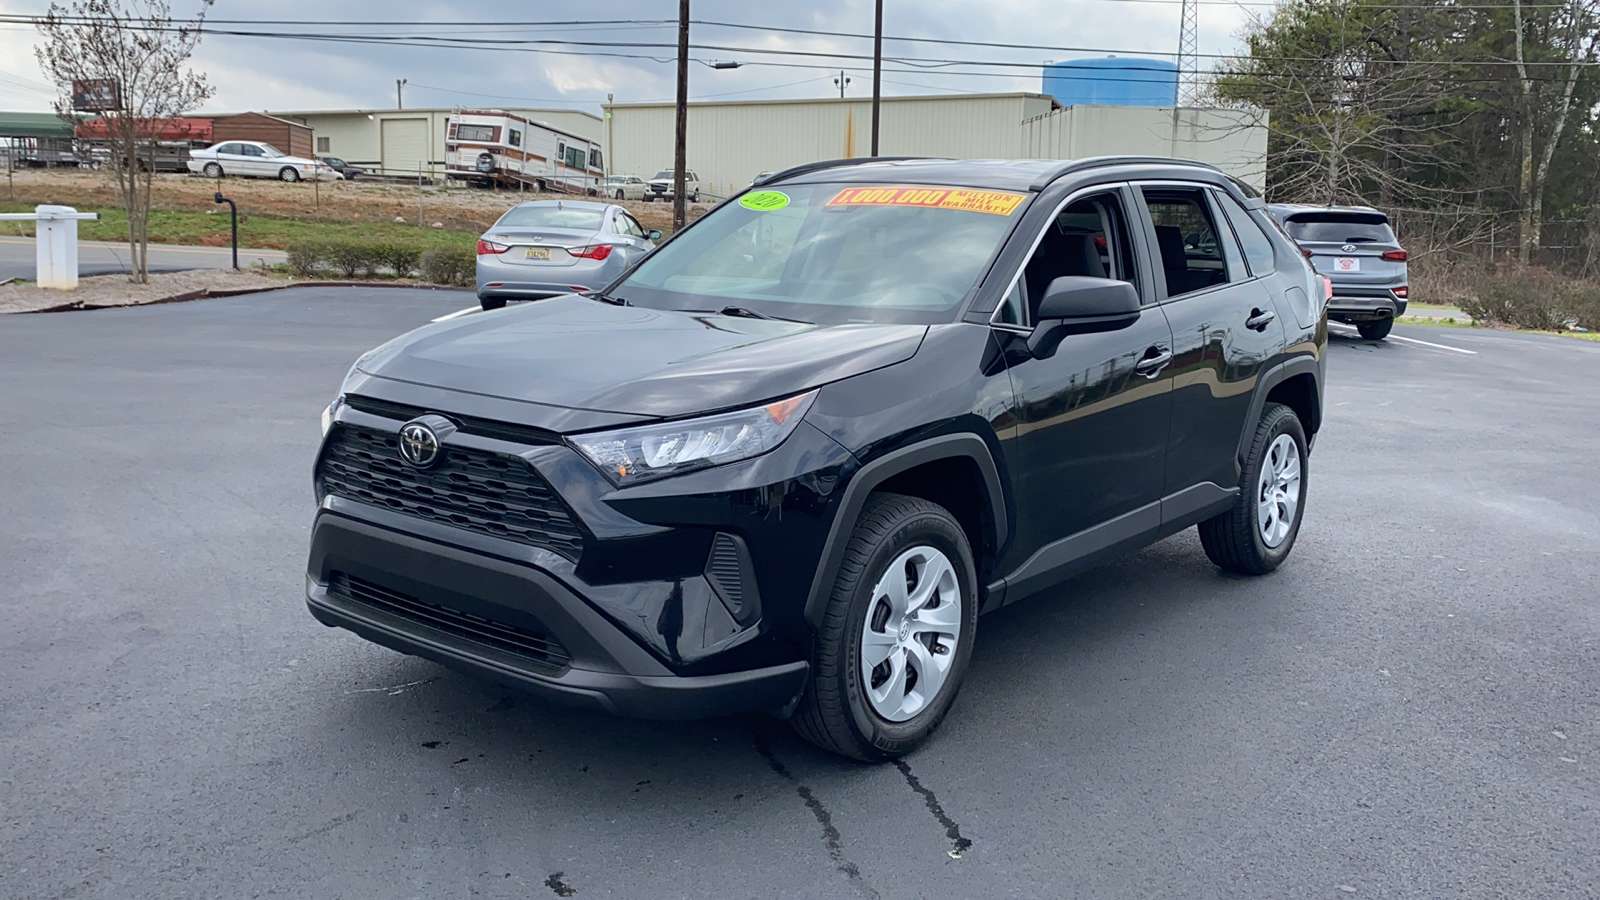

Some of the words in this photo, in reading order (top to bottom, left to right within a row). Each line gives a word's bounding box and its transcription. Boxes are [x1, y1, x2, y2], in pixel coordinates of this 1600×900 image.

[837, 189, 947, 205] 1,000,000
[956, 191, 1013, 202] MILLION
[965, 197, 994, 205] MILE
[941, 200, 1008, 213] WARRANTY
